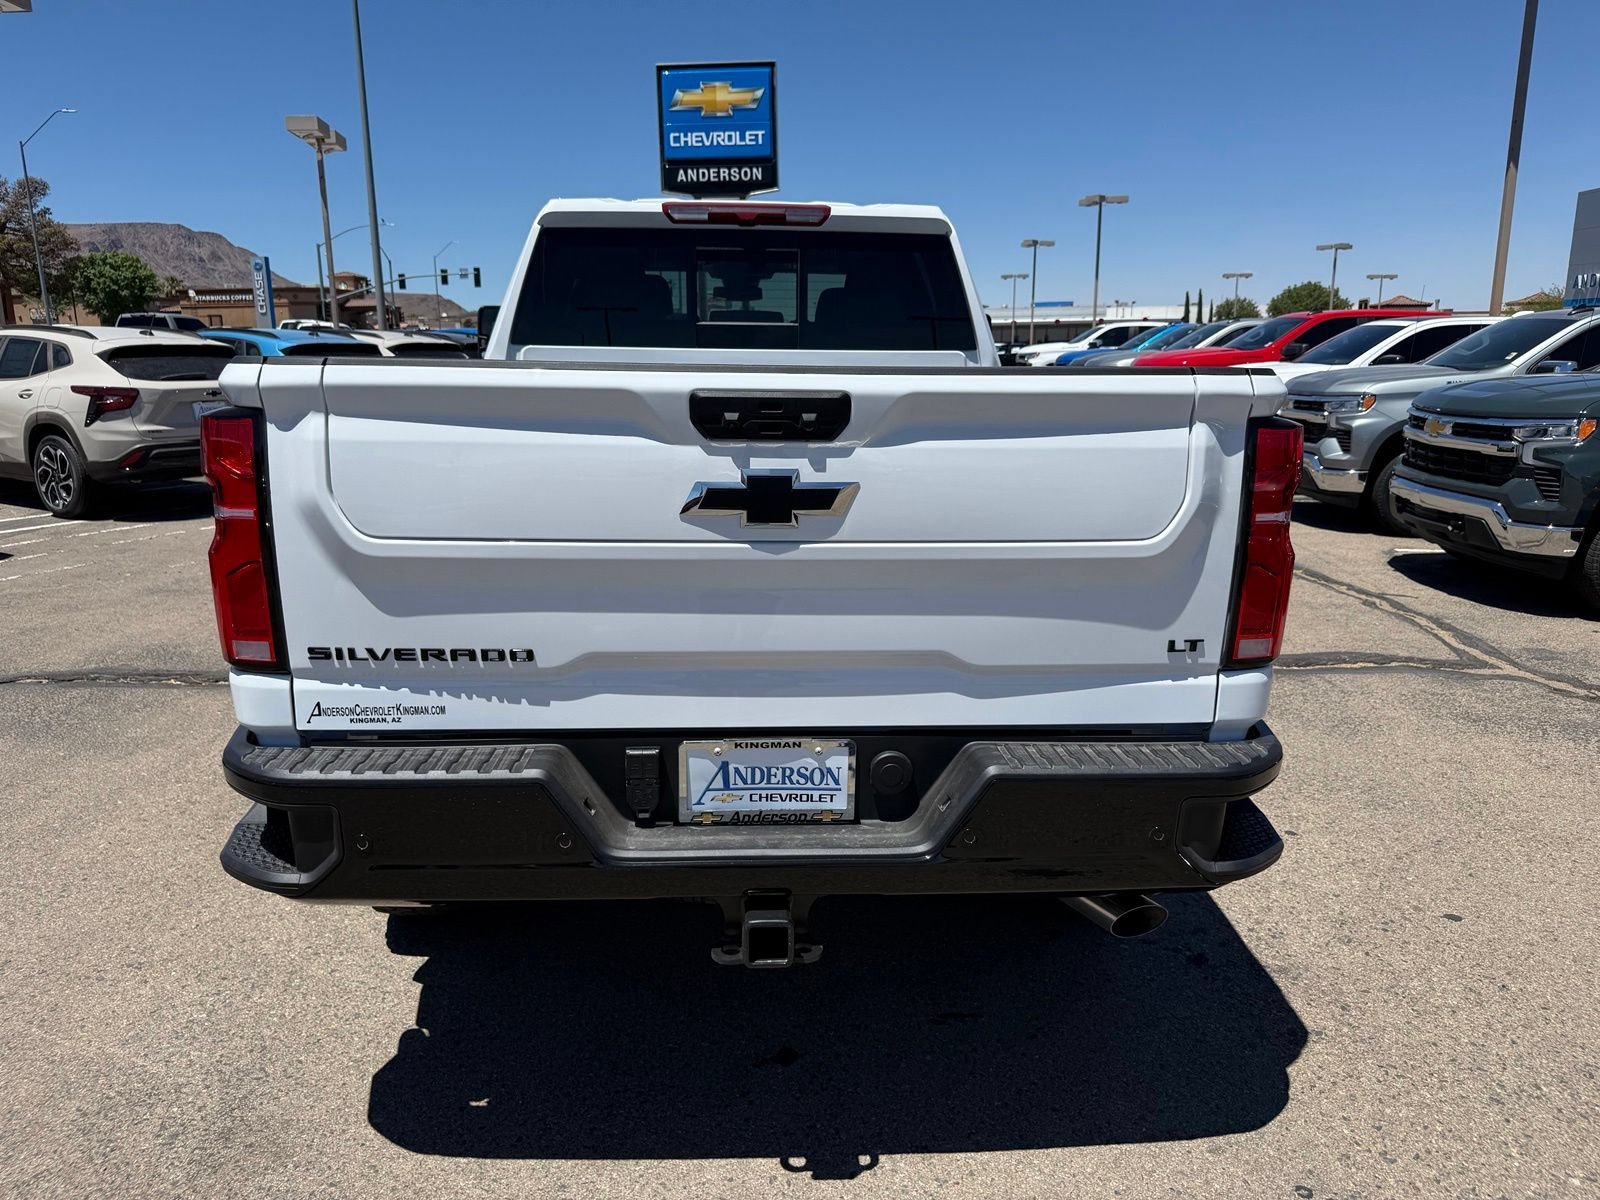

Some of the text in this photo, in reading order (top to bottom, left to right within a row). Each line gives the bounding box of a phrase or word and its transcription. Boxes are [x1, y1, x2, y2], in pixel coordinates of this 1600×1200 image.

[669, 130, 766, 147] CHEVROLET
[677, 166, 763, 183] ANDERSON
[1572, 272, 1600, 289] AND
[254, 271, 267, 314] CHASE
[1167, 638, 1205, 653] LT
[306, 646, 536, 663] SILVERADO
[349, 717, 390, 725] KINGMAN,
[733, 740, 802, 749] KINGMAN
[692, 760, 842, 806] ANDERSON
[749, 792, 837, 803] CHEVROLET
[728, 810, 808, 825] Anderson
